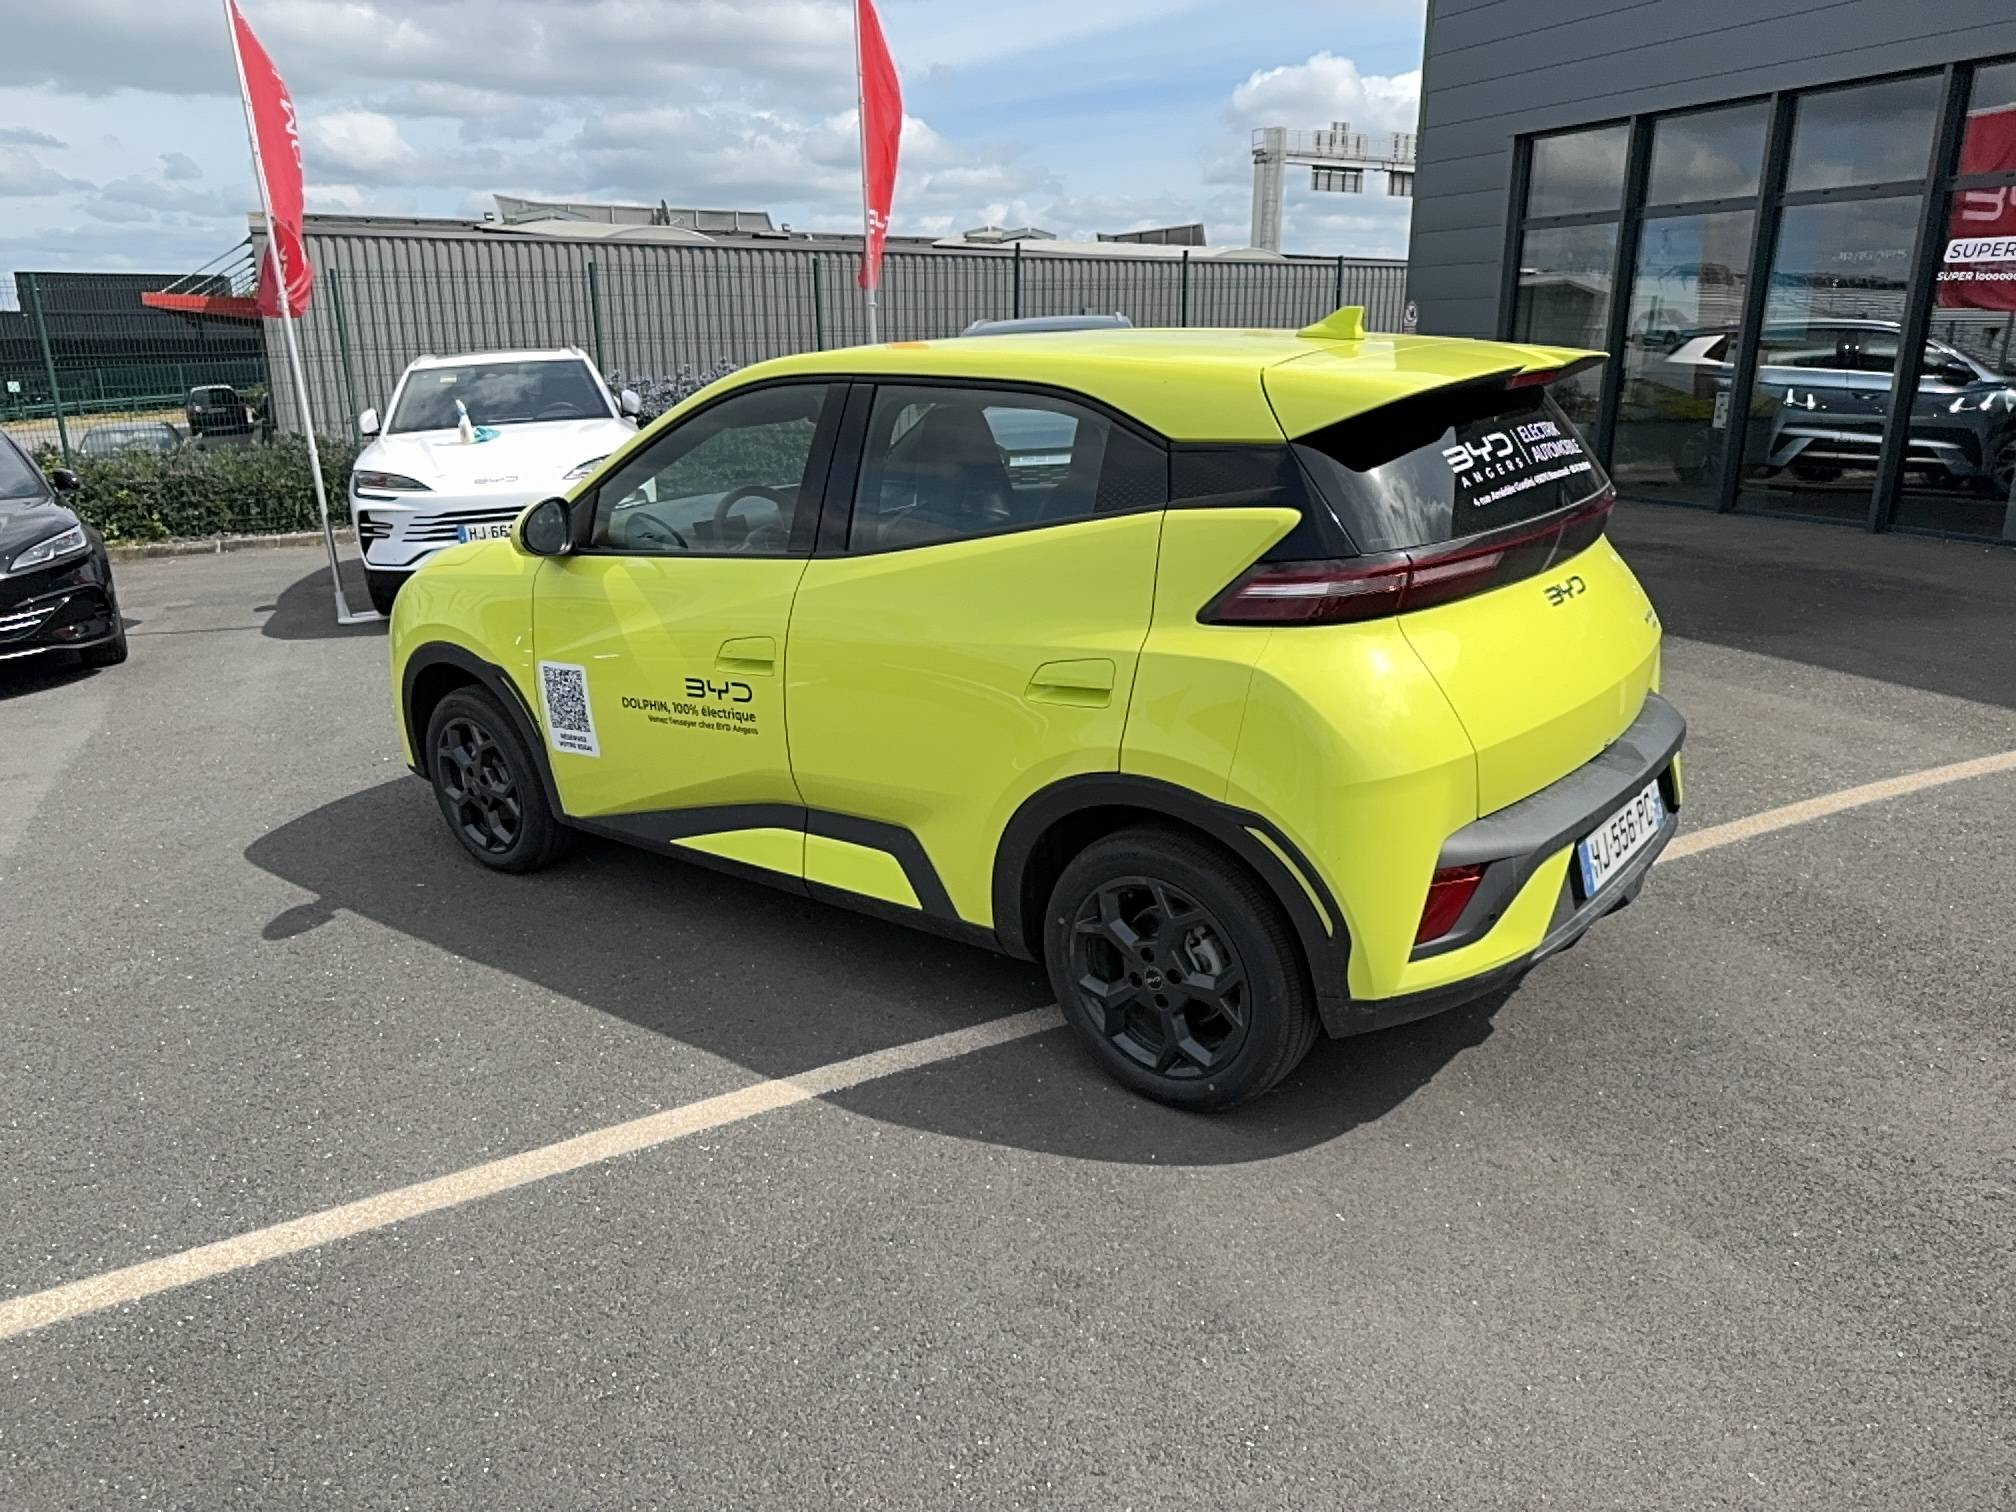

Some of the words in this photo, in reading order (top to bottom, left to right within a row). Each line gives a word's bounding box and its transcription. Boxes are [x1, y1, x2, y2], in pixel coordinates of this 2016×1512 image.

[1950, 242, 2016, 259] SUPER
[1936, 271, 1974, 281] SUPER
[1442, 432, 1514, 474] BYD
[1461, 457, 1524, 489] ANGERS
[469, 524, 513, 540] HJ-66
[1544, 575, 1586, 607] BYD
[684, 677, 753, 703] BYD
[621, 696, 671, 714] DOLPHIN,
[672, 701, 699, 717] 100%
[701, 704, 756, 723] électrique
[698, 721, 715, 730] chez
[716, 722, 731, 731] BYD
